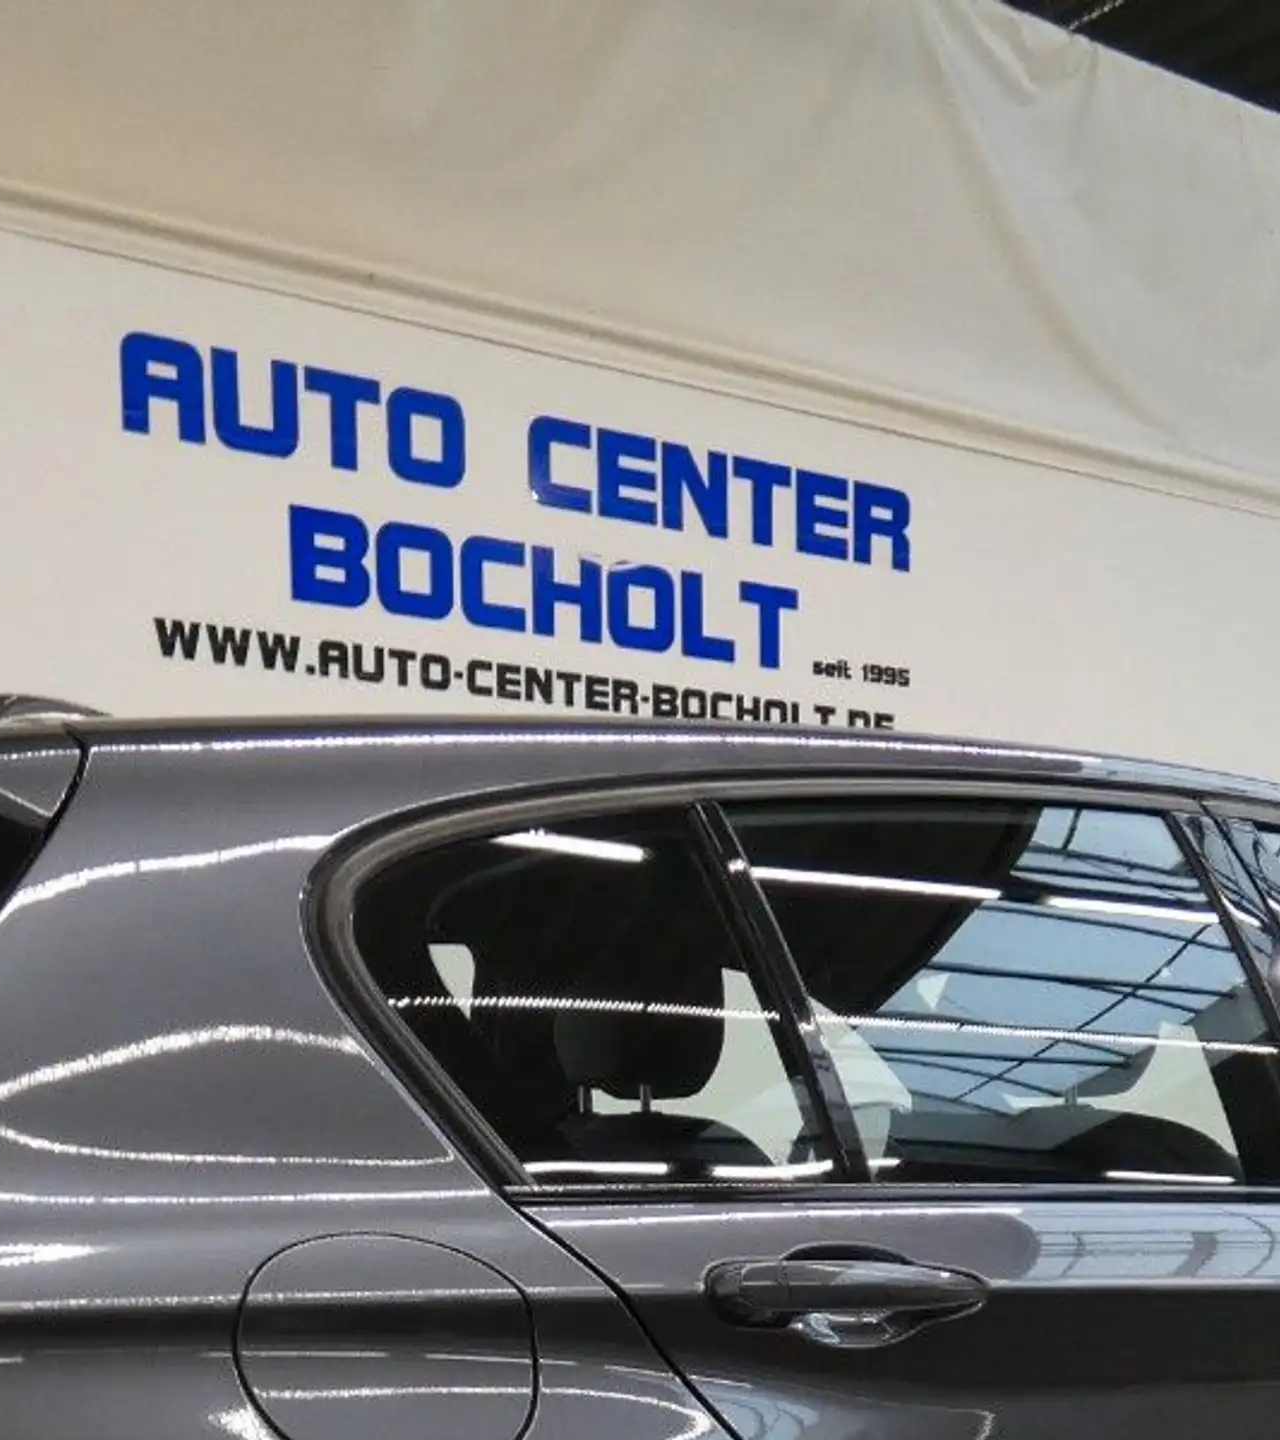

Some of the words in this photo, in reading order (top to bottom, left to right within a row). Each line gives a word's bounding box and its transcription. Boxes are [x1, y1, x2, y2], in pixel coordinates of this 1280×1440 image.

[120, 332, 466, 489] AUTO
[528, 416, 911, 571] CENTER
[288, 504, 799, 670] BOCHOLT
[812, 659, 852, 680] seit
[862, 664, 910, 687] 1995
